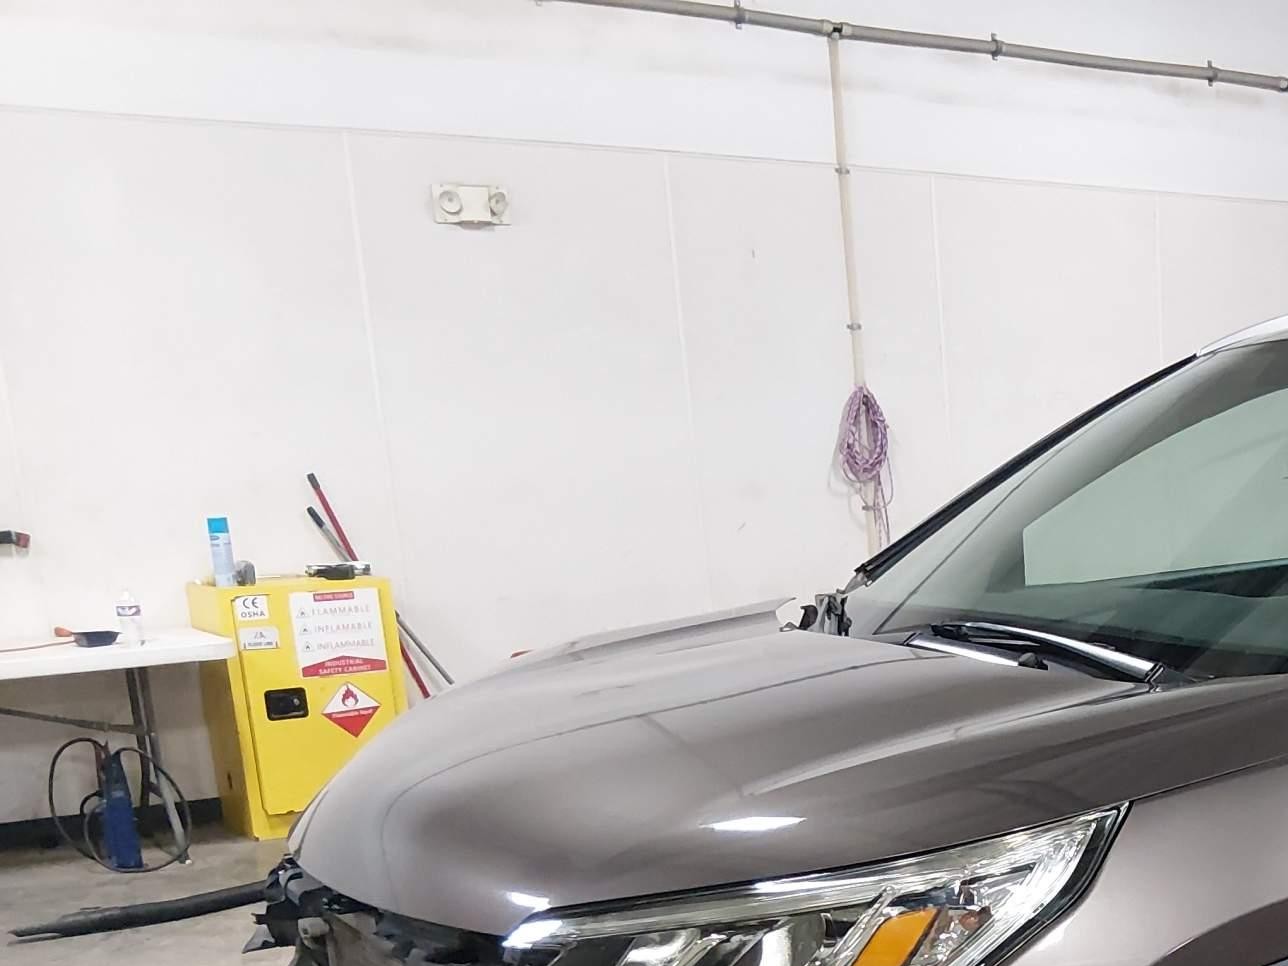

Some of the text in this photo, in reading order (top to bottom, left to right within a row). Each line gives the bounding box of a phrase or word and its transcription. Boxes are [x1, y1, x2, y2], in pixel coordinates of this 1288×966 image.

[242, 597, 259, 609] CE
[241, 610, 266, 618] OSHA
[312, 605, 370, 616] FLAMMABLE
[314, 622, 372, 633] INFLAMABLE
[317, 639, 375, 650] INFLAMMABLE
[324, 658, 364, 667] INDUSTRIAL
[318, 664, 371, 675] SAFETY CABINET
